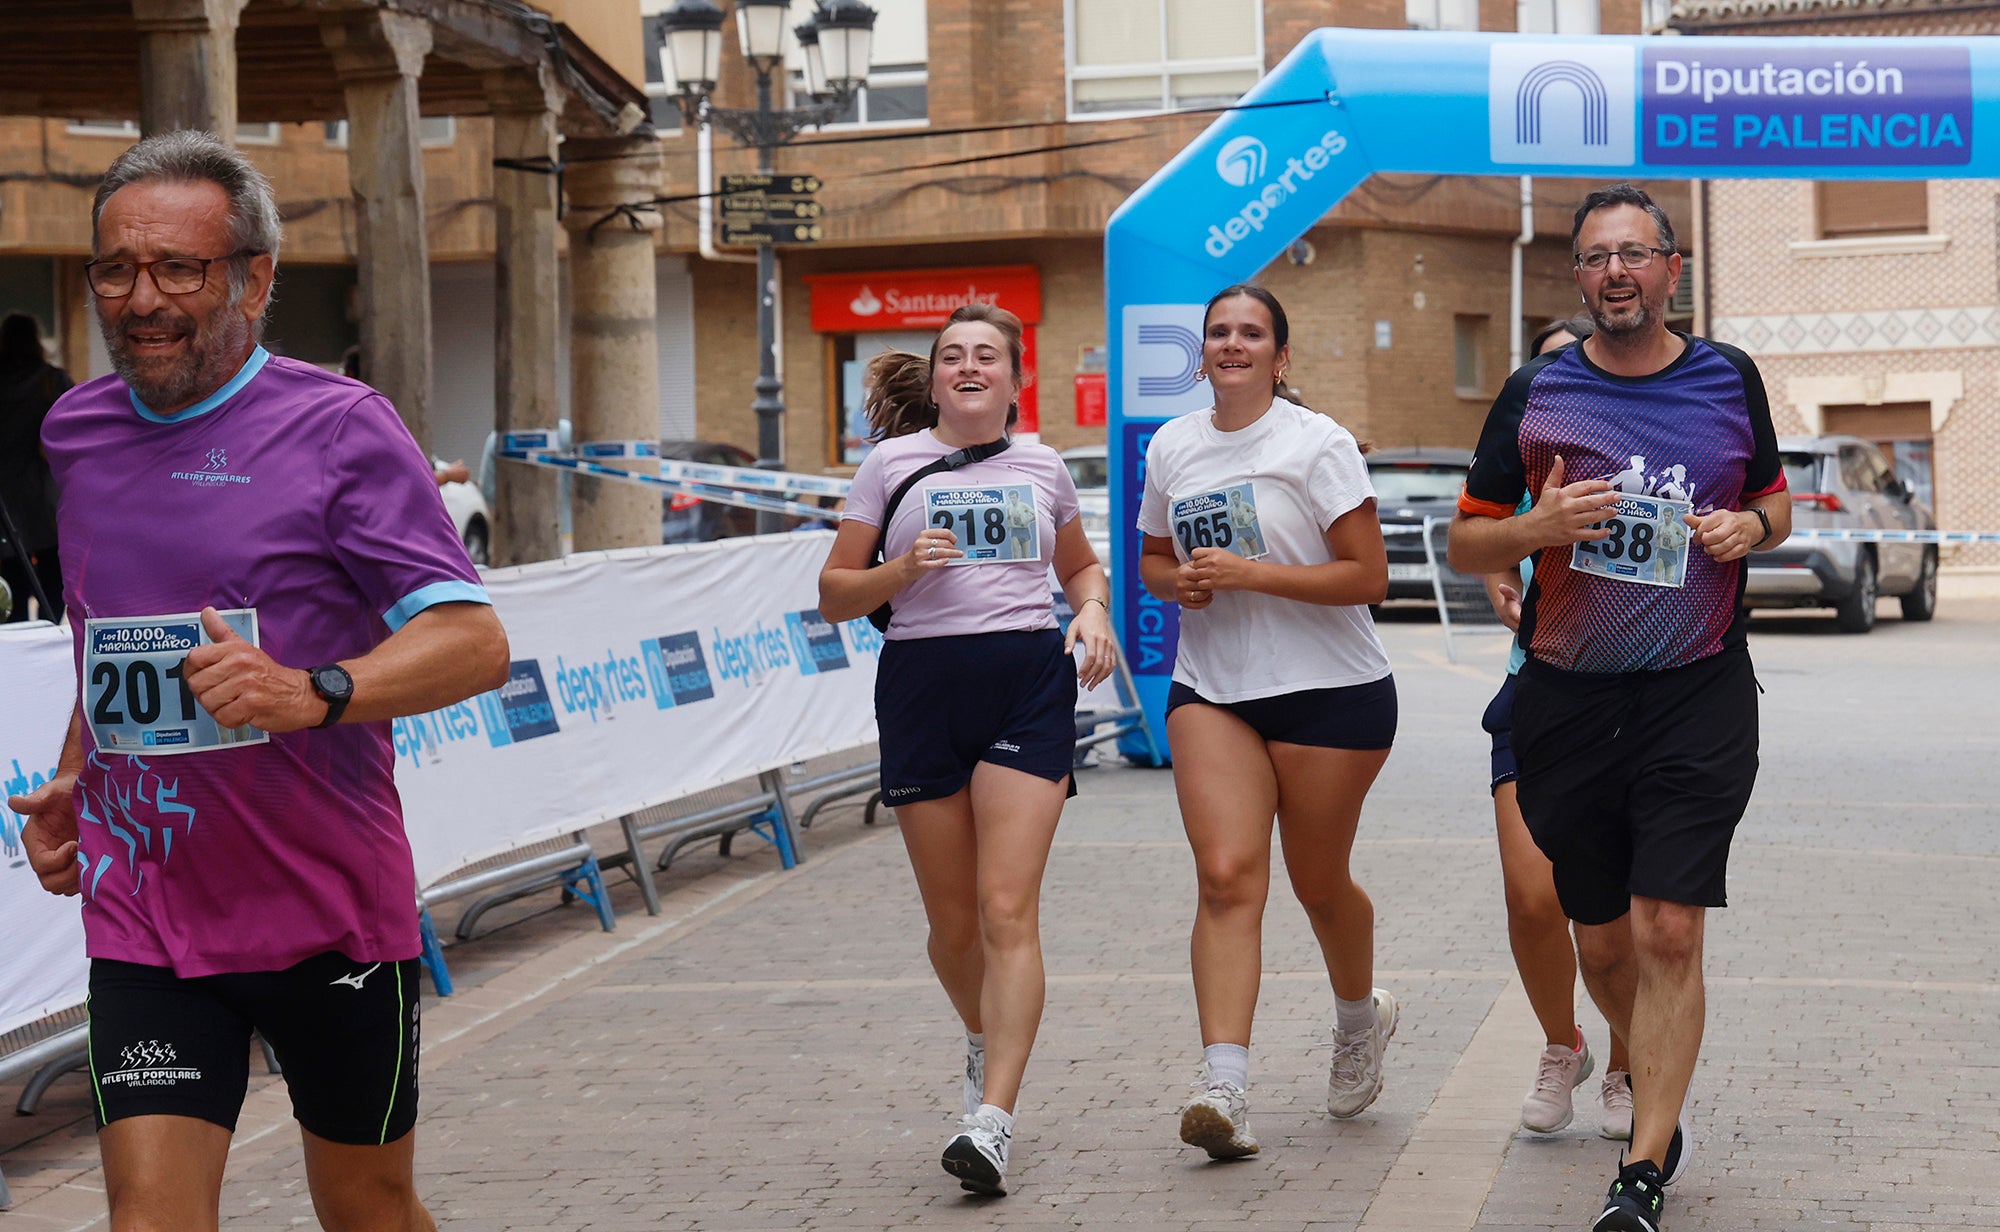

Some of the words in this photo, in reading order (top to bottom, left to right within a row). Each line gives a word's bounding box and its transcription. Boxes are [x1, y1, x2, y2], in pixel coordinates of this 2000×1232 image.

[1656, 60, 1903, 103] Diputación
[1656, 114, 1718, 148] DE
[1733, 113, 1964, 148] PALENCIA
[1205, 130, 1347, 258] deportes
[885, 285, 999, 314] Santander
[171, 472, 204, 481] ATLETAS
[205, 475, 252, 484] POPULARES
[949, 492, 983, 500] 10.000
[1185, 497, 1209, 508] 10.000
[932, 508, 1006, 546] 218
[1177, 511, 1232, 554] 265
[116, 627, 165, 642] 10.000
[165, 633, 177, 641] de
[98, 642, 149, 652] MARIANO
[152, 638, 191, 650] HARO
[92, 658, 197, 725] 201
[889, 786, 921, 797] OYSHO
[101, 1072, 140, 1085] ATLETAS
[142, 1070, 202, 1080] POPULARES
[127, 1079, 176, 1088] VALLADOLID
